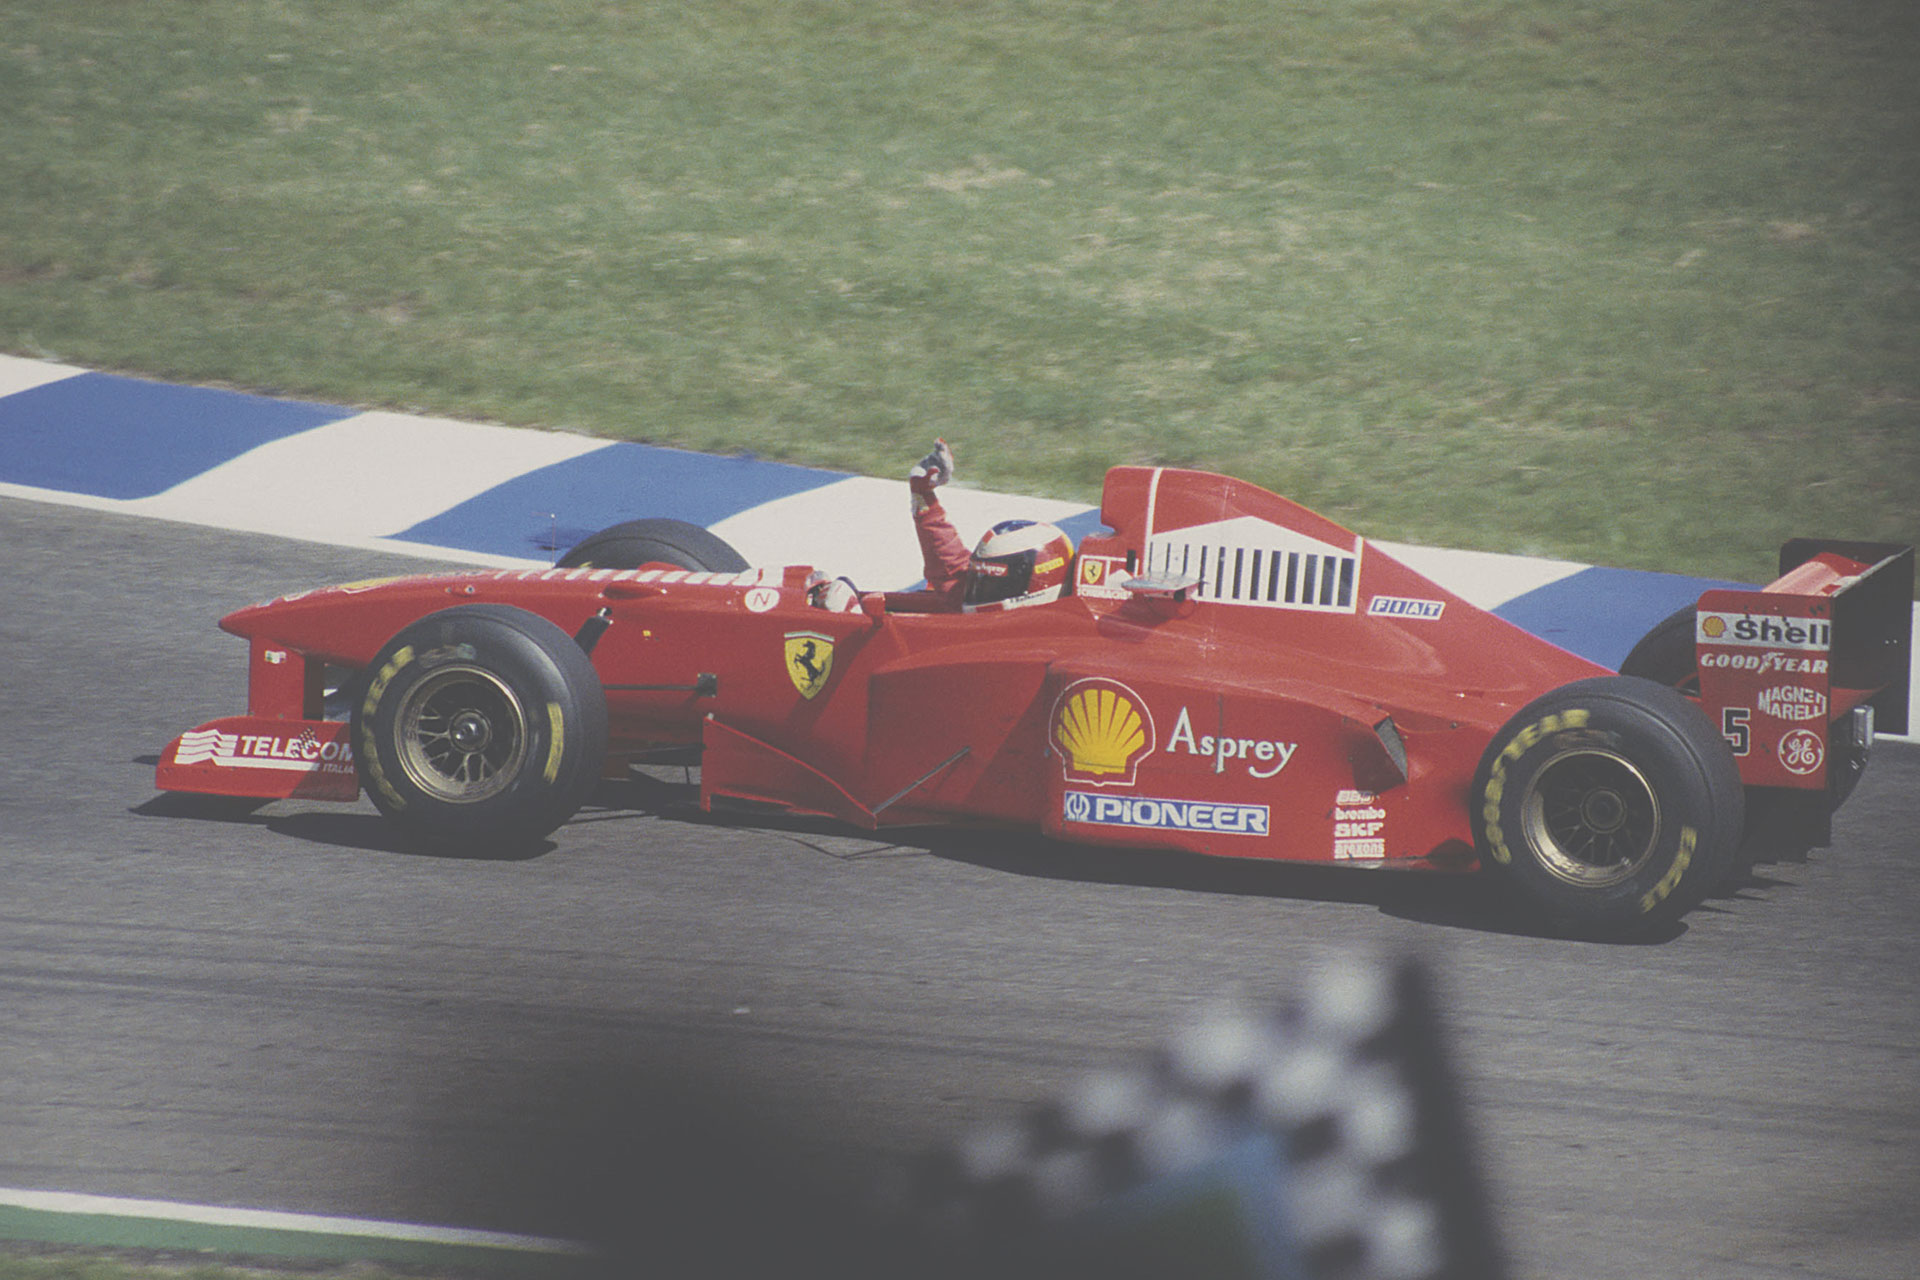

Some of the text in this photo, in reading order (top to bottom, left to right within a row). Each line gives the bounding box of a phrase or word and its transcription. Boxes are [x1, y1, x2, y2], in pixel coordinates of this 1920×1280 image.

[753, 592, 771, 606] N
[1372, 599, 1442, 617] FIAT
[1734, 617, 1829, 645] Shell
[1701, 652, 1829, 674] GOODYEAR
[1166, 706, 1298, 778] Asprey
[1722, 707, 1750, 756] 5
[1095, 797, 1267, 832] PIONEER
[1335, 806, 1386, 820] brembo
[1334, 823, 1384, 837] SKF
